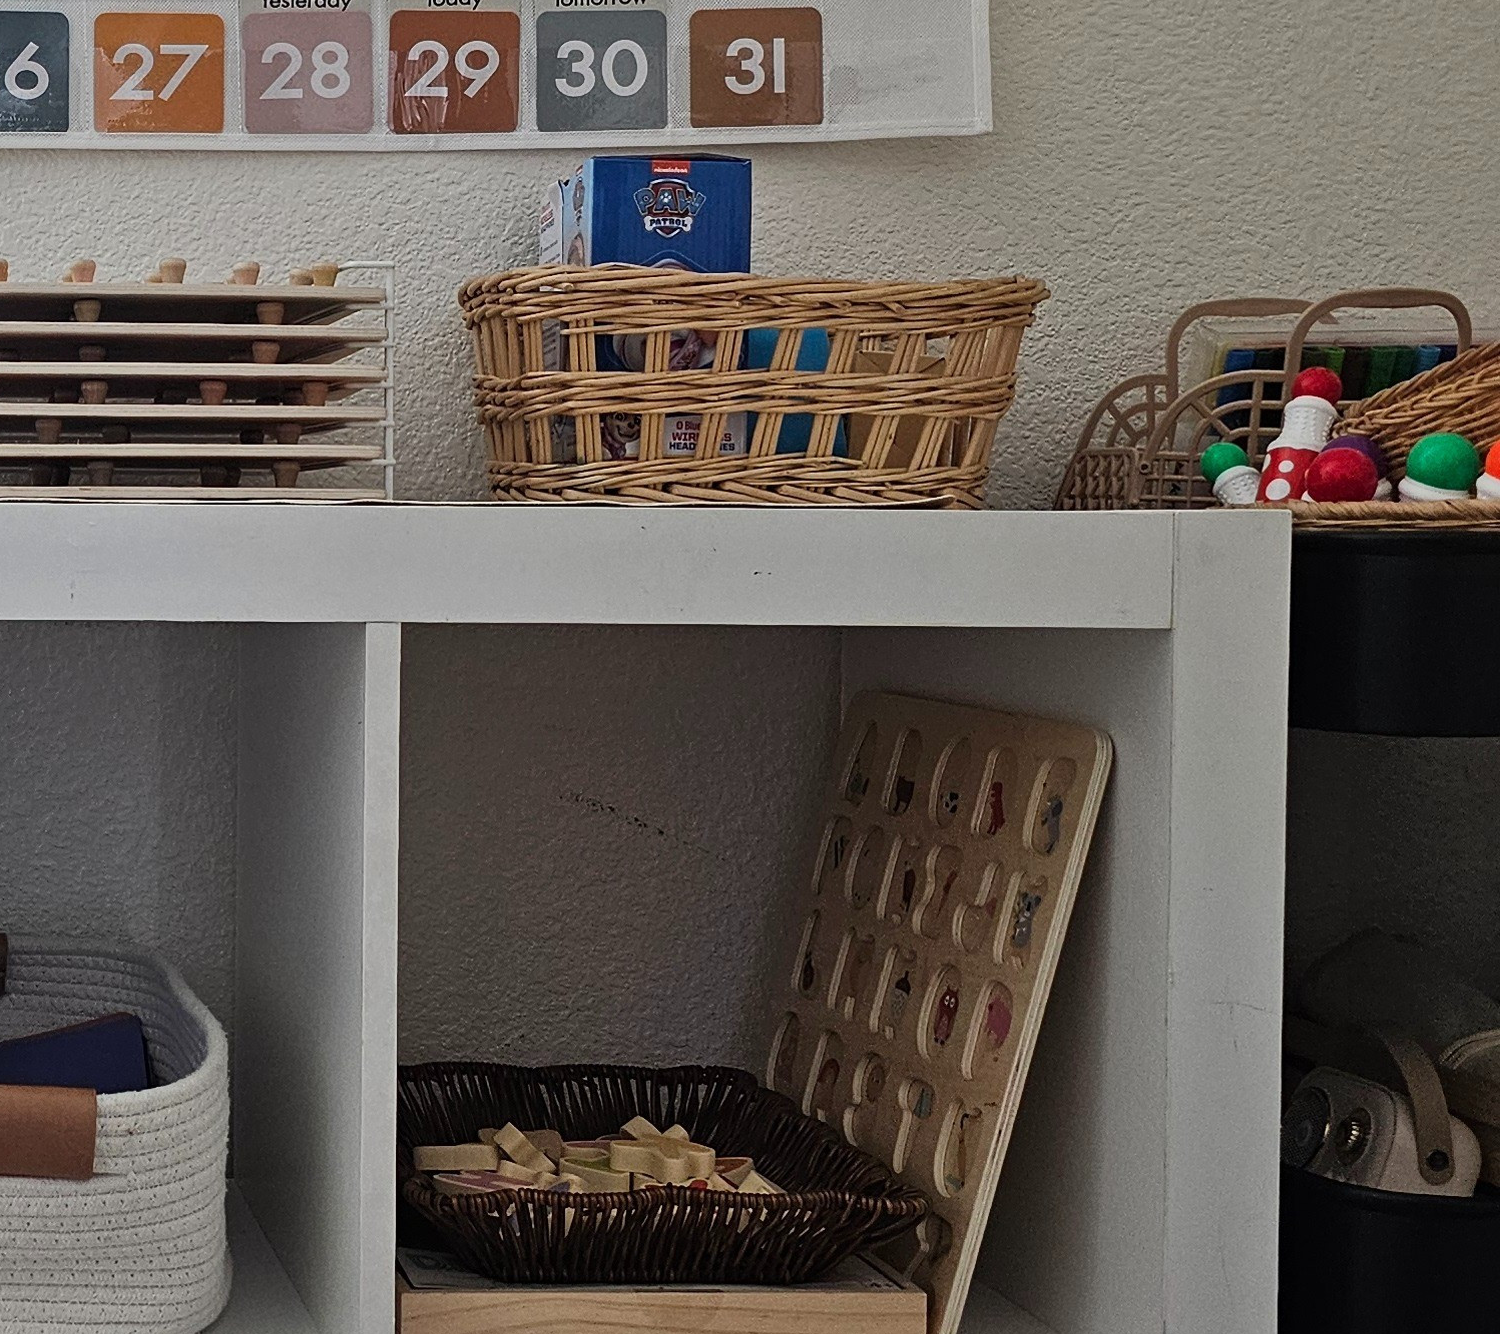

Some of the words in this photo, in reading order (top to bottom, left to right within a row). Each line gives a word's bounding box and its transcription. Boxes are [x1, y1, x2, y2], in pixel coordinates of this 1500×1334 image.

[109, 43, 209, 102] 27
[258, 41, 351, 100] 28
[403, 40, 500, 99] 29
[554, 39, 649, 97] 30
[724, 37, 786, 95] 31
[633, 188, 707, 216] PAW
[649, 217, 687, 228] PATROL
[671, 432, 732, 442] WIRS
